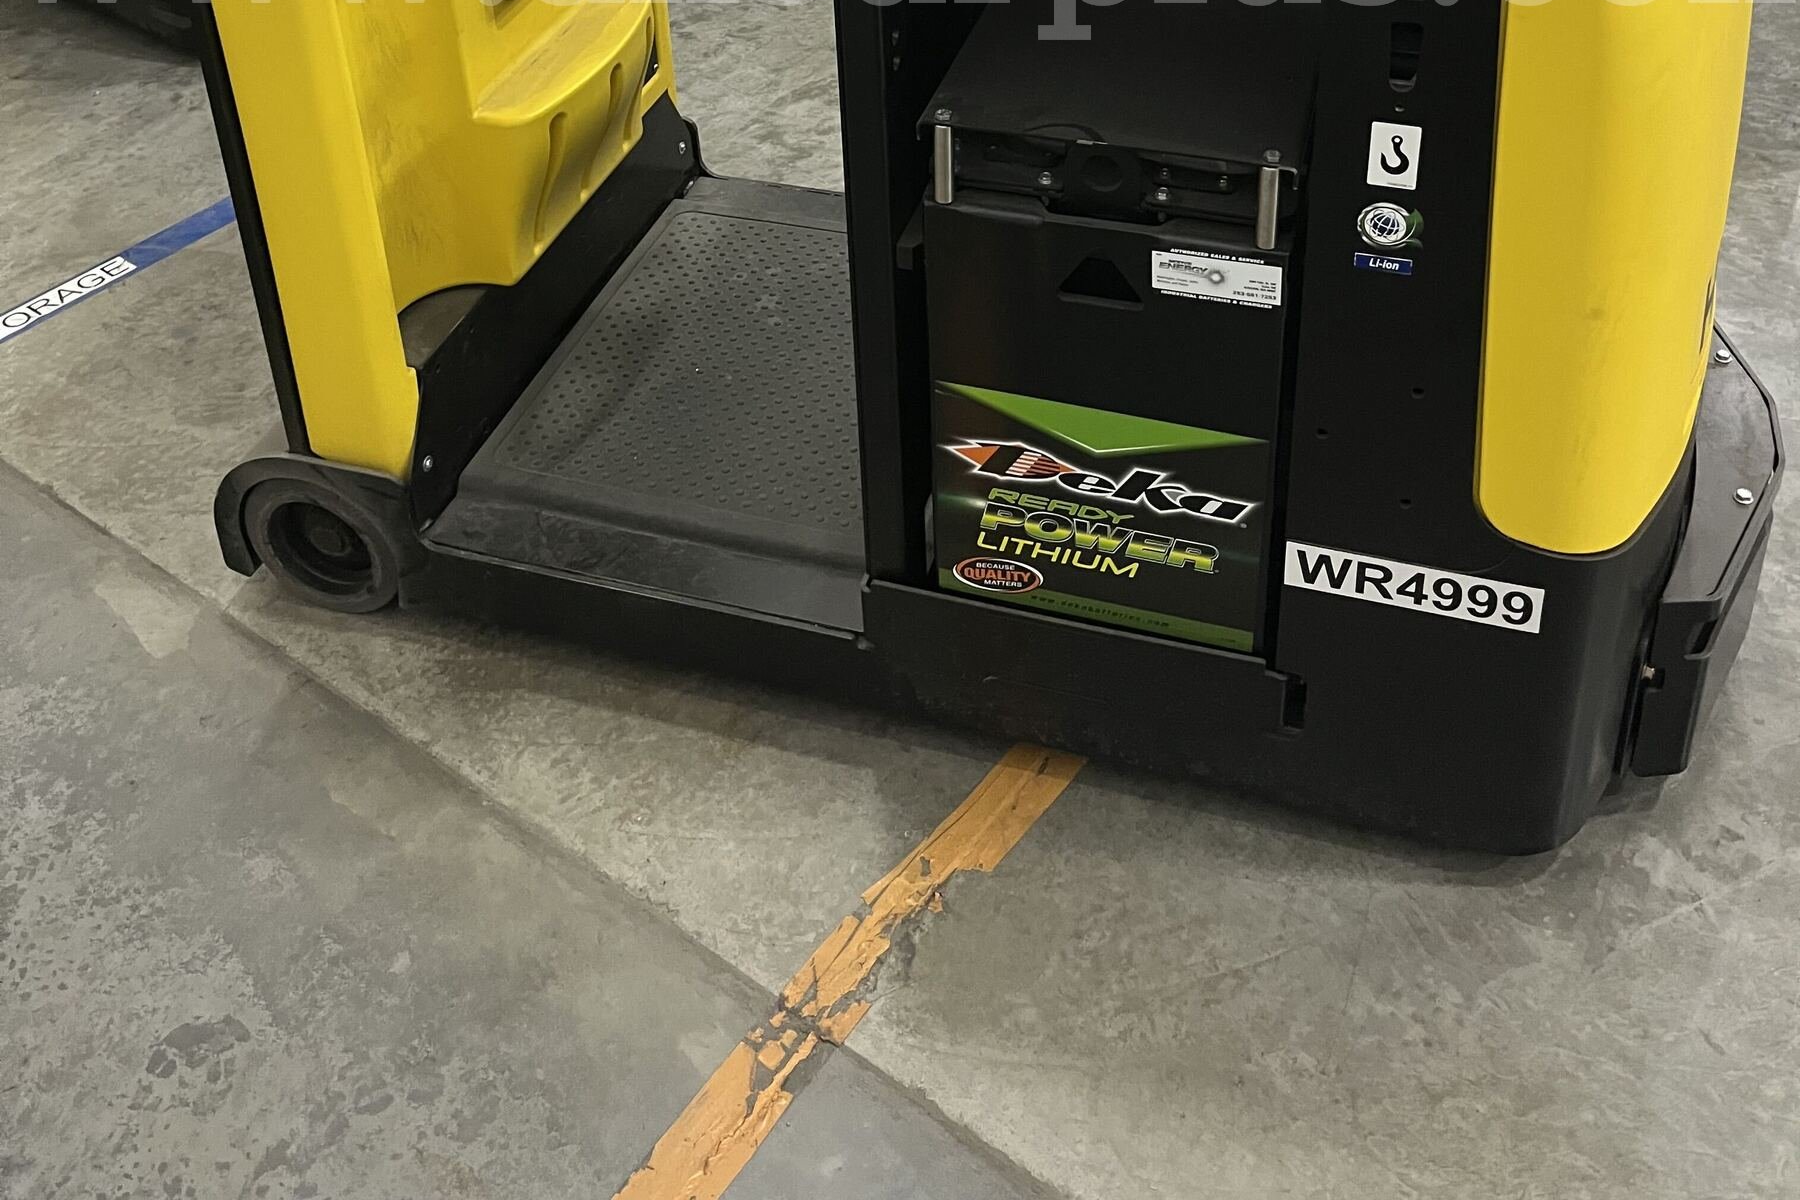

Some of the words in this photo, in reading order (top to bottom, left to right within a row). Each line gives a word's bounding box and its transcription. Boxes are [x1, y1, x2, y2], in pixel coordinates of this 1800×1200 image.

[1159, 261, 1208, 275] ENERGY
[1369, 257, 1400, 271] Li-ion
[941, 438, 1257, 524] Deka
[988, 487, 1134, 524] READY
[980, 501, 1220, 575] POWER
[976, 531, 1140, 579] LITHIUM
[976, 562, 1016, 570] BECAUSE
[963, 567, 1031, 583] QUALITY
[983, 579, 1022, 587] MATTERS
[1296, 548, 1534, 626] WR4999
